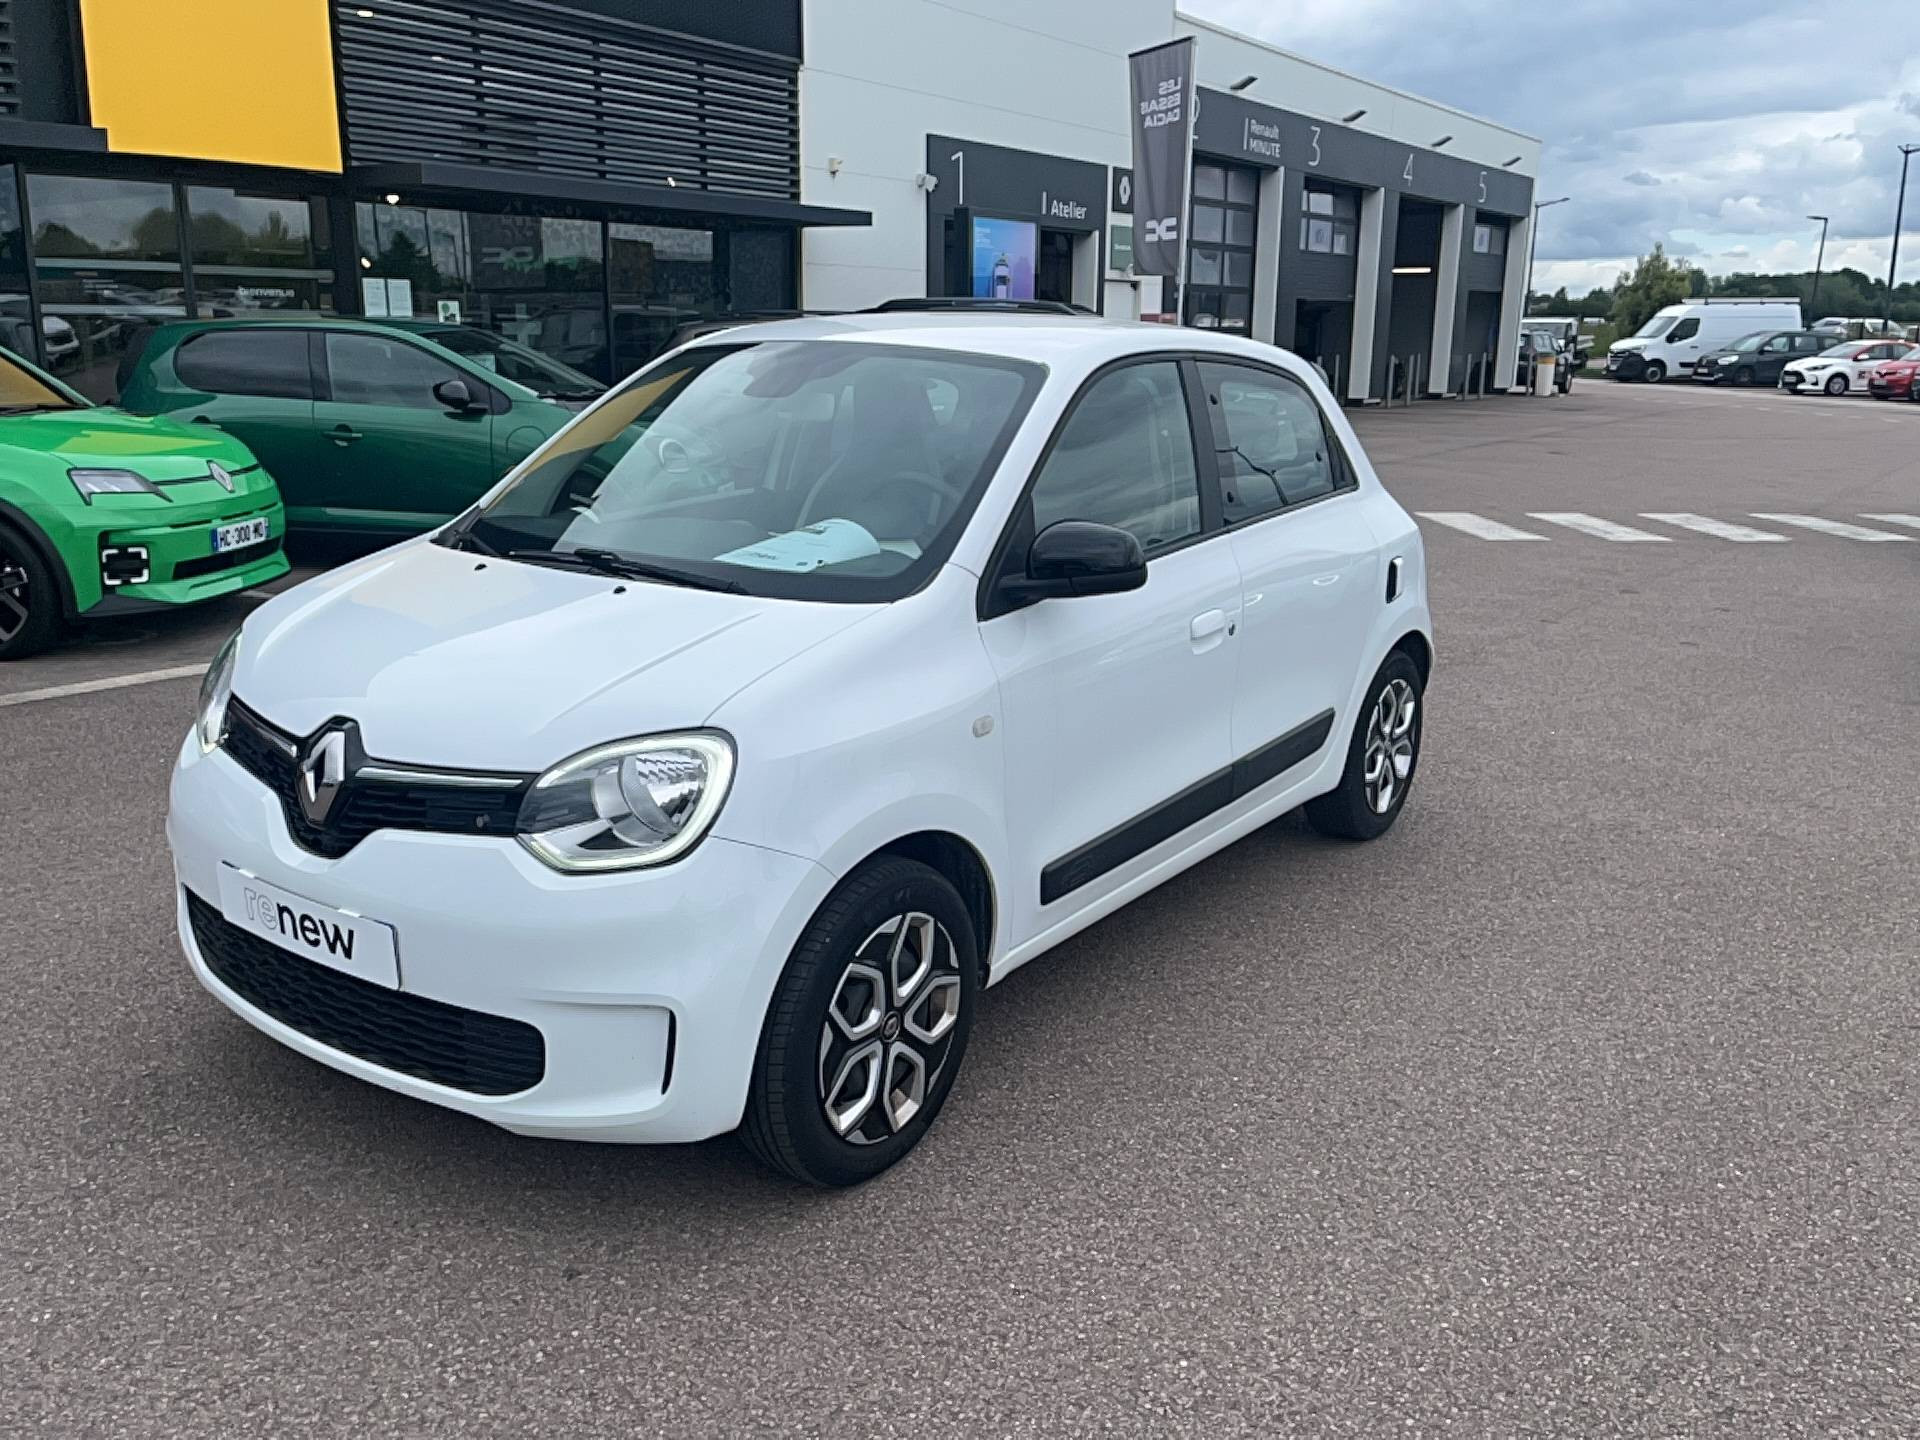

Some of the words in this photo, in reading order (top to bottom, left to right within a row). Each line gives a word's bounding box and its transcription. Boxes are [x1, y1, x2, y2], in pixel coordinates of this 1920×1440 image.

[1250, 119, 1280, 140] Renault
[1308, 125, 1321, 167] 3
[1249, 138, 1281, 158] MINUTE
[951, 151, 964, 205] 1
[1403, 153, 1414, 187] 4
[1478, 171, 1488, 203] 5
[1050, 199, 1087, 219] Atelier
[244, 887, 355, 961] renew
